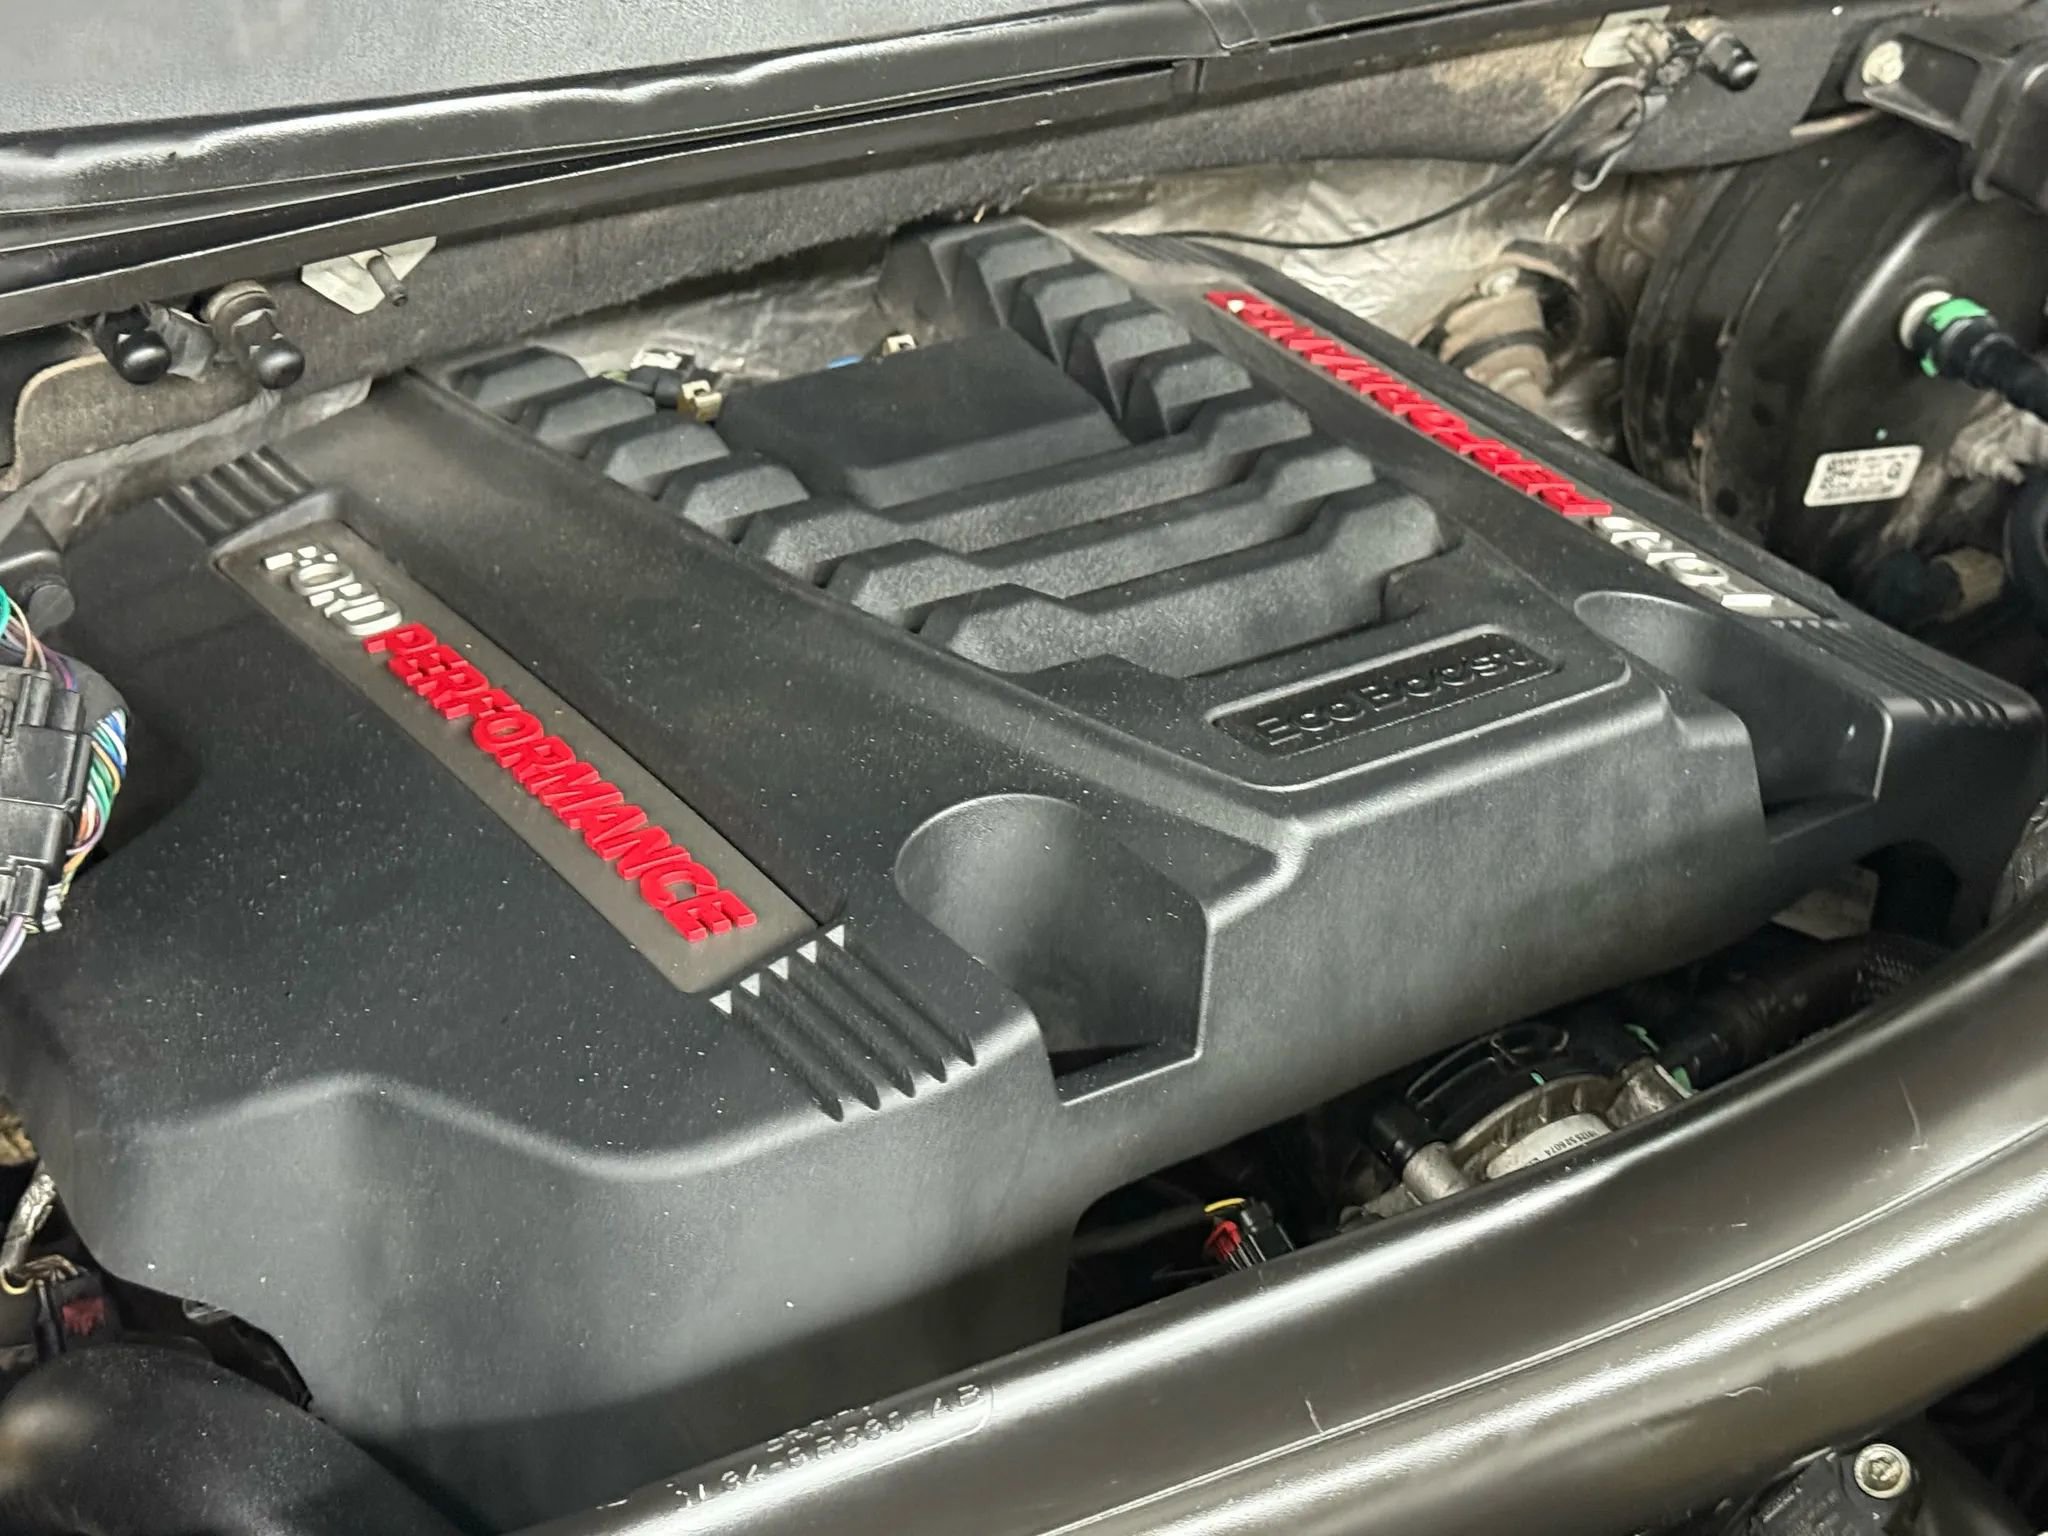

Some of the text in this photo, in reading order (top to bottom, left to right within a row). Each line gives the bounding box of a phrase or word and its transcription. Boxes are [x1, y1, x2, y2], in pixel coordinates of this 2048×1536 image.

[264, 545, 758, 944] FORD PERFORMANCE
[1256, 647, 1535, 747] EcoBoost
